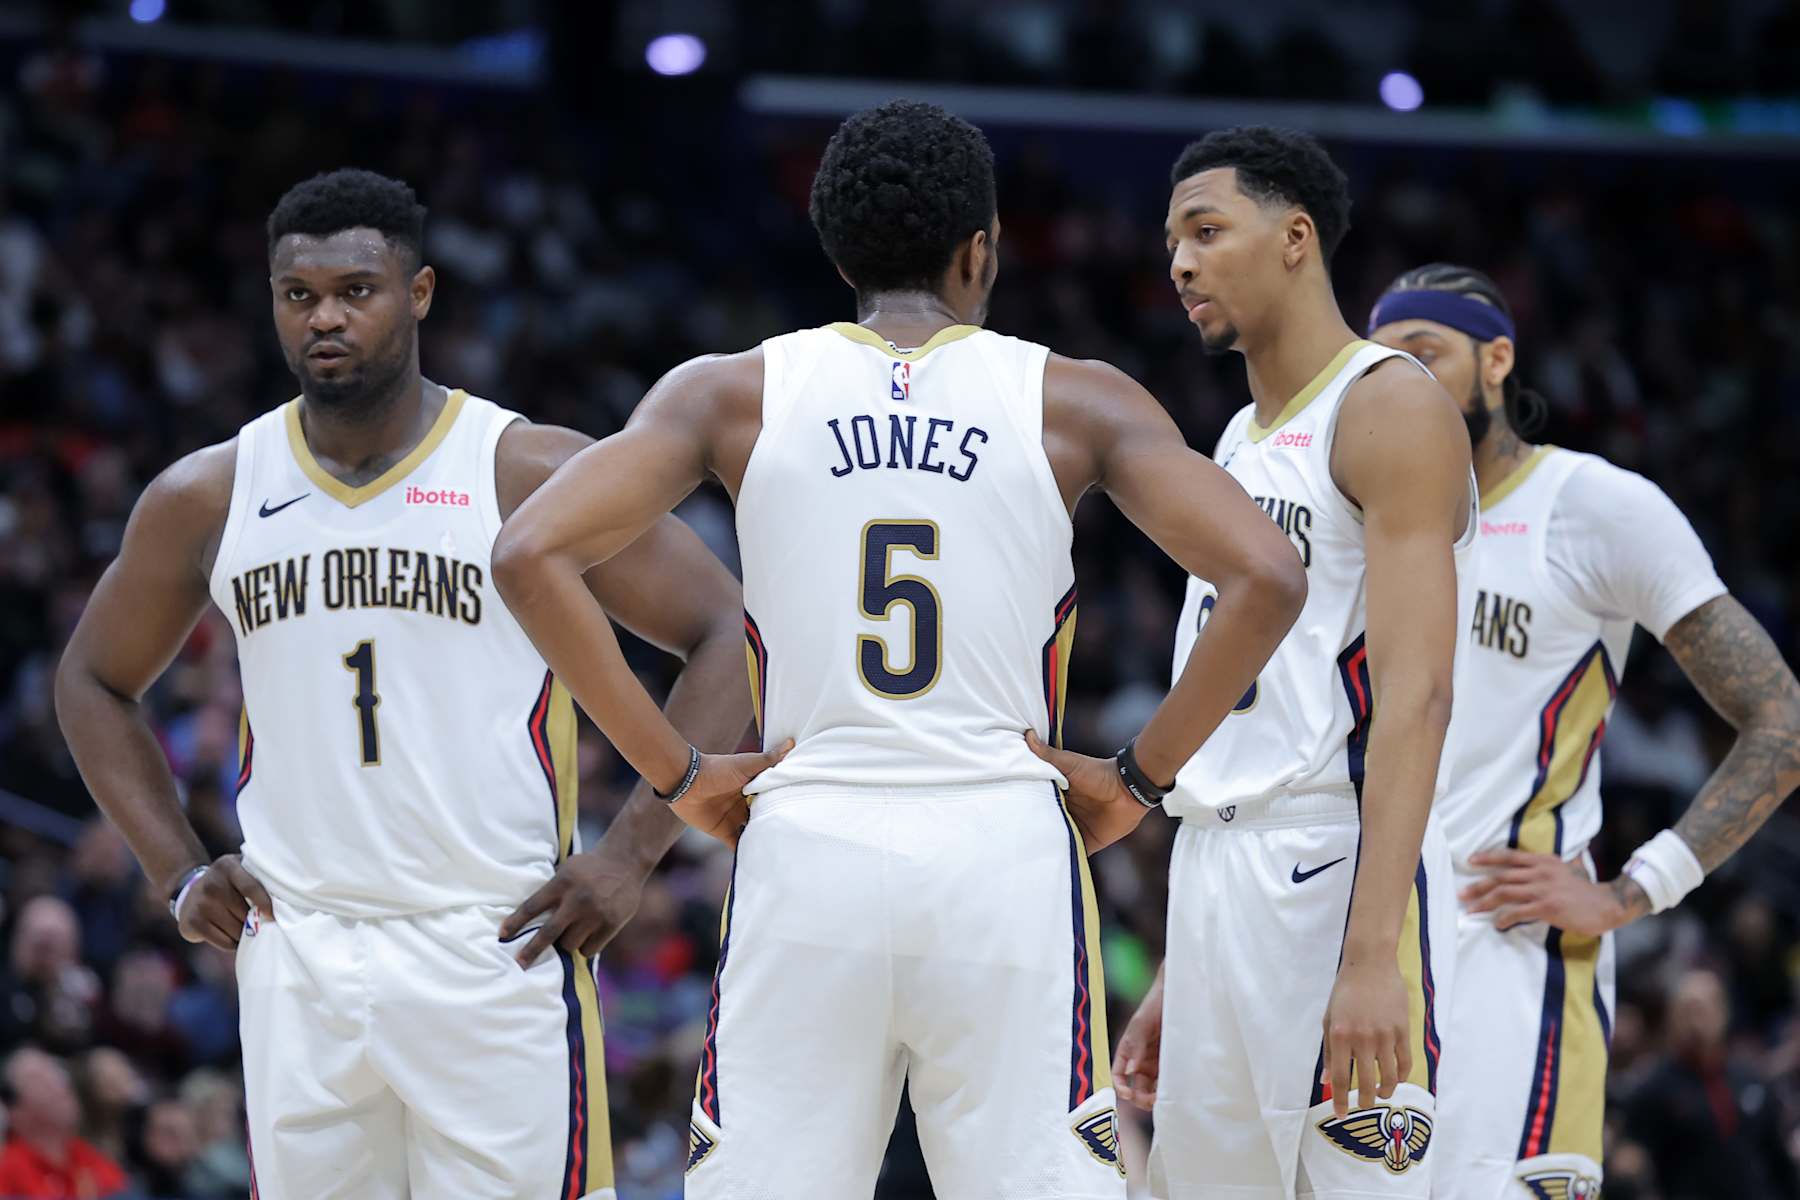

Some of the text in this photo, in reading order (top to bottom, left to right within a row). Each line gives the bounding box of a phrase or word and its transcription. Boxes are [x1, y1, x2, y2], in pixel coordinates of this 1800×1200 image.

[827, 414, 988, 482] JONES
[406, 487, 470, 506] ibotta
[231, 546, 484, 638] NEW ORLEANS
[856, 518, 943, 701] 5
[342, 638, 382, 767] 1
